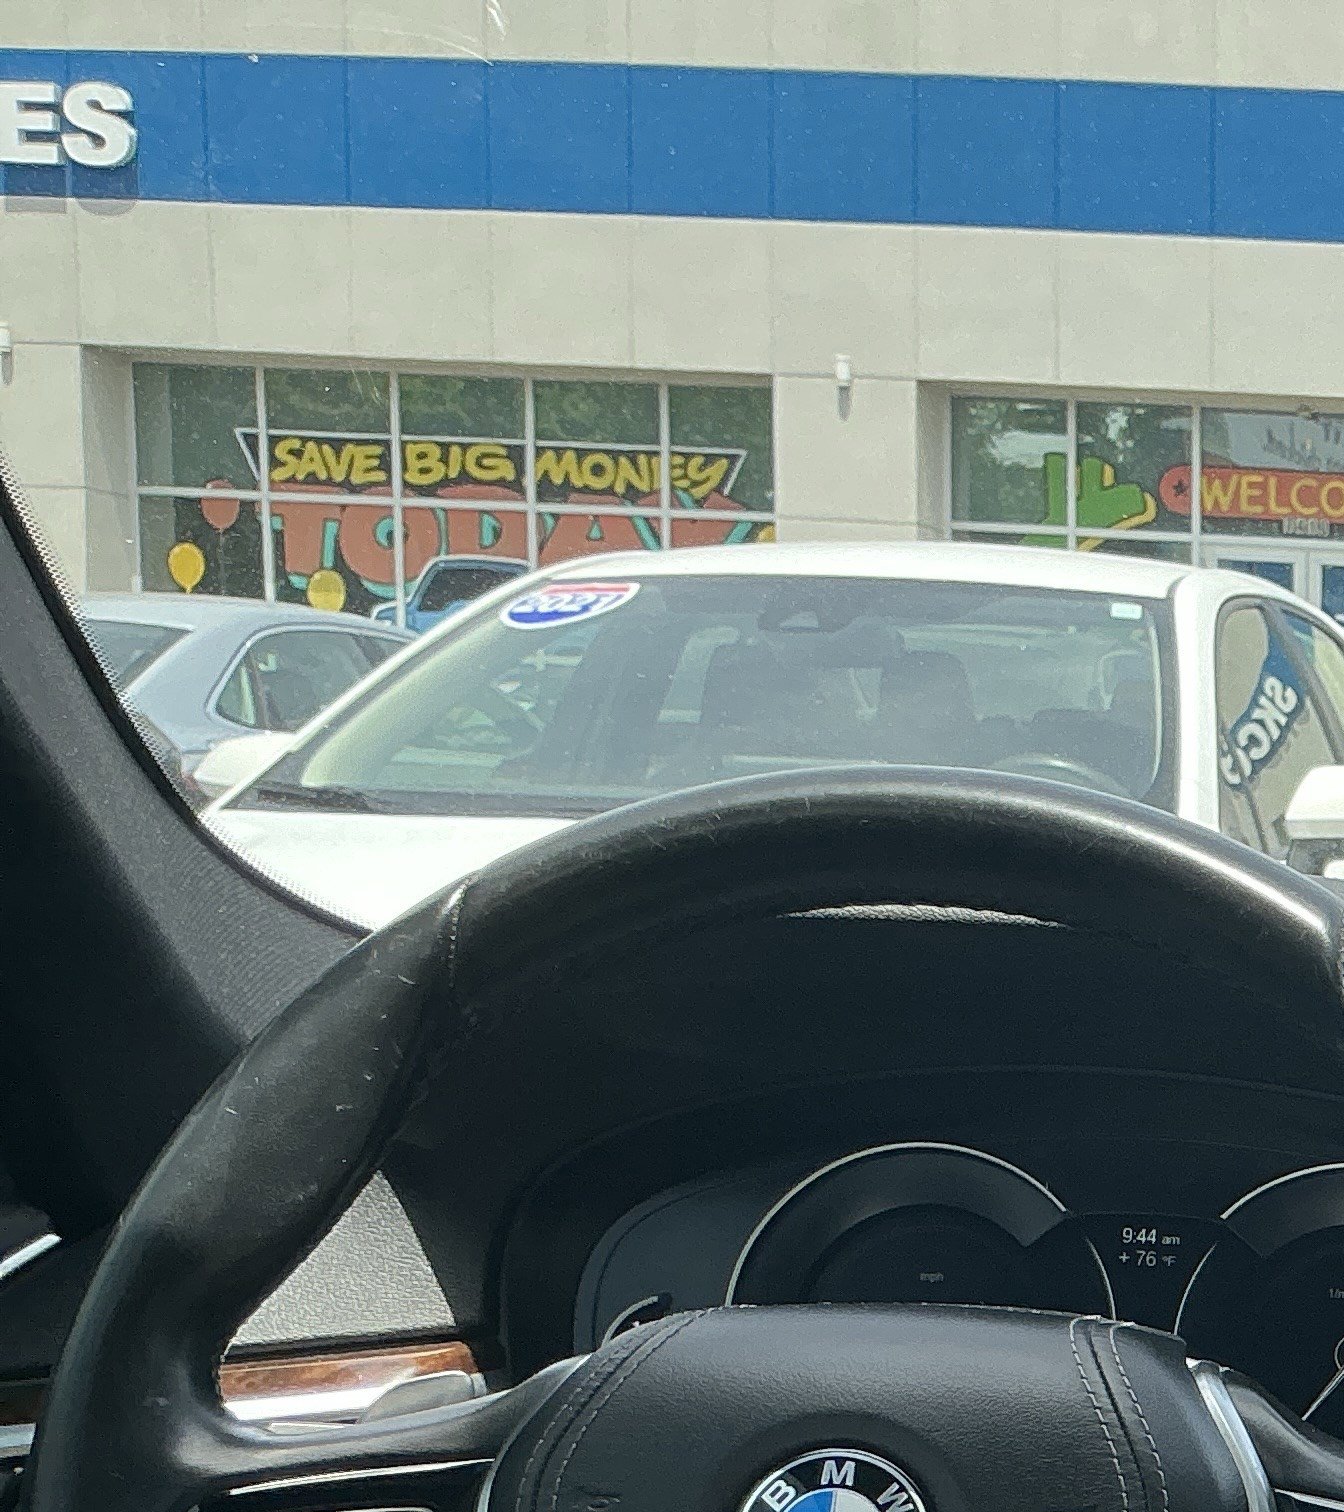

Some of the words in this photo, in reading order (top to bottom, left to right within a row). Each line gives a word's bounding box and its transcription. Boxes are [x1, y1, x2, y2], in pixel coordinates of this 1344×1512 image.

[270, 438, 389, 484] SAVE
[401, 441, 518, 486] BIG
[534, 448, 732, 497] MONEY
[1122, 1227, 1158, 1246] 9:44
[1161, 1235, 1181, 1246] am
[1136, 1250, 1157, 1268] 76
